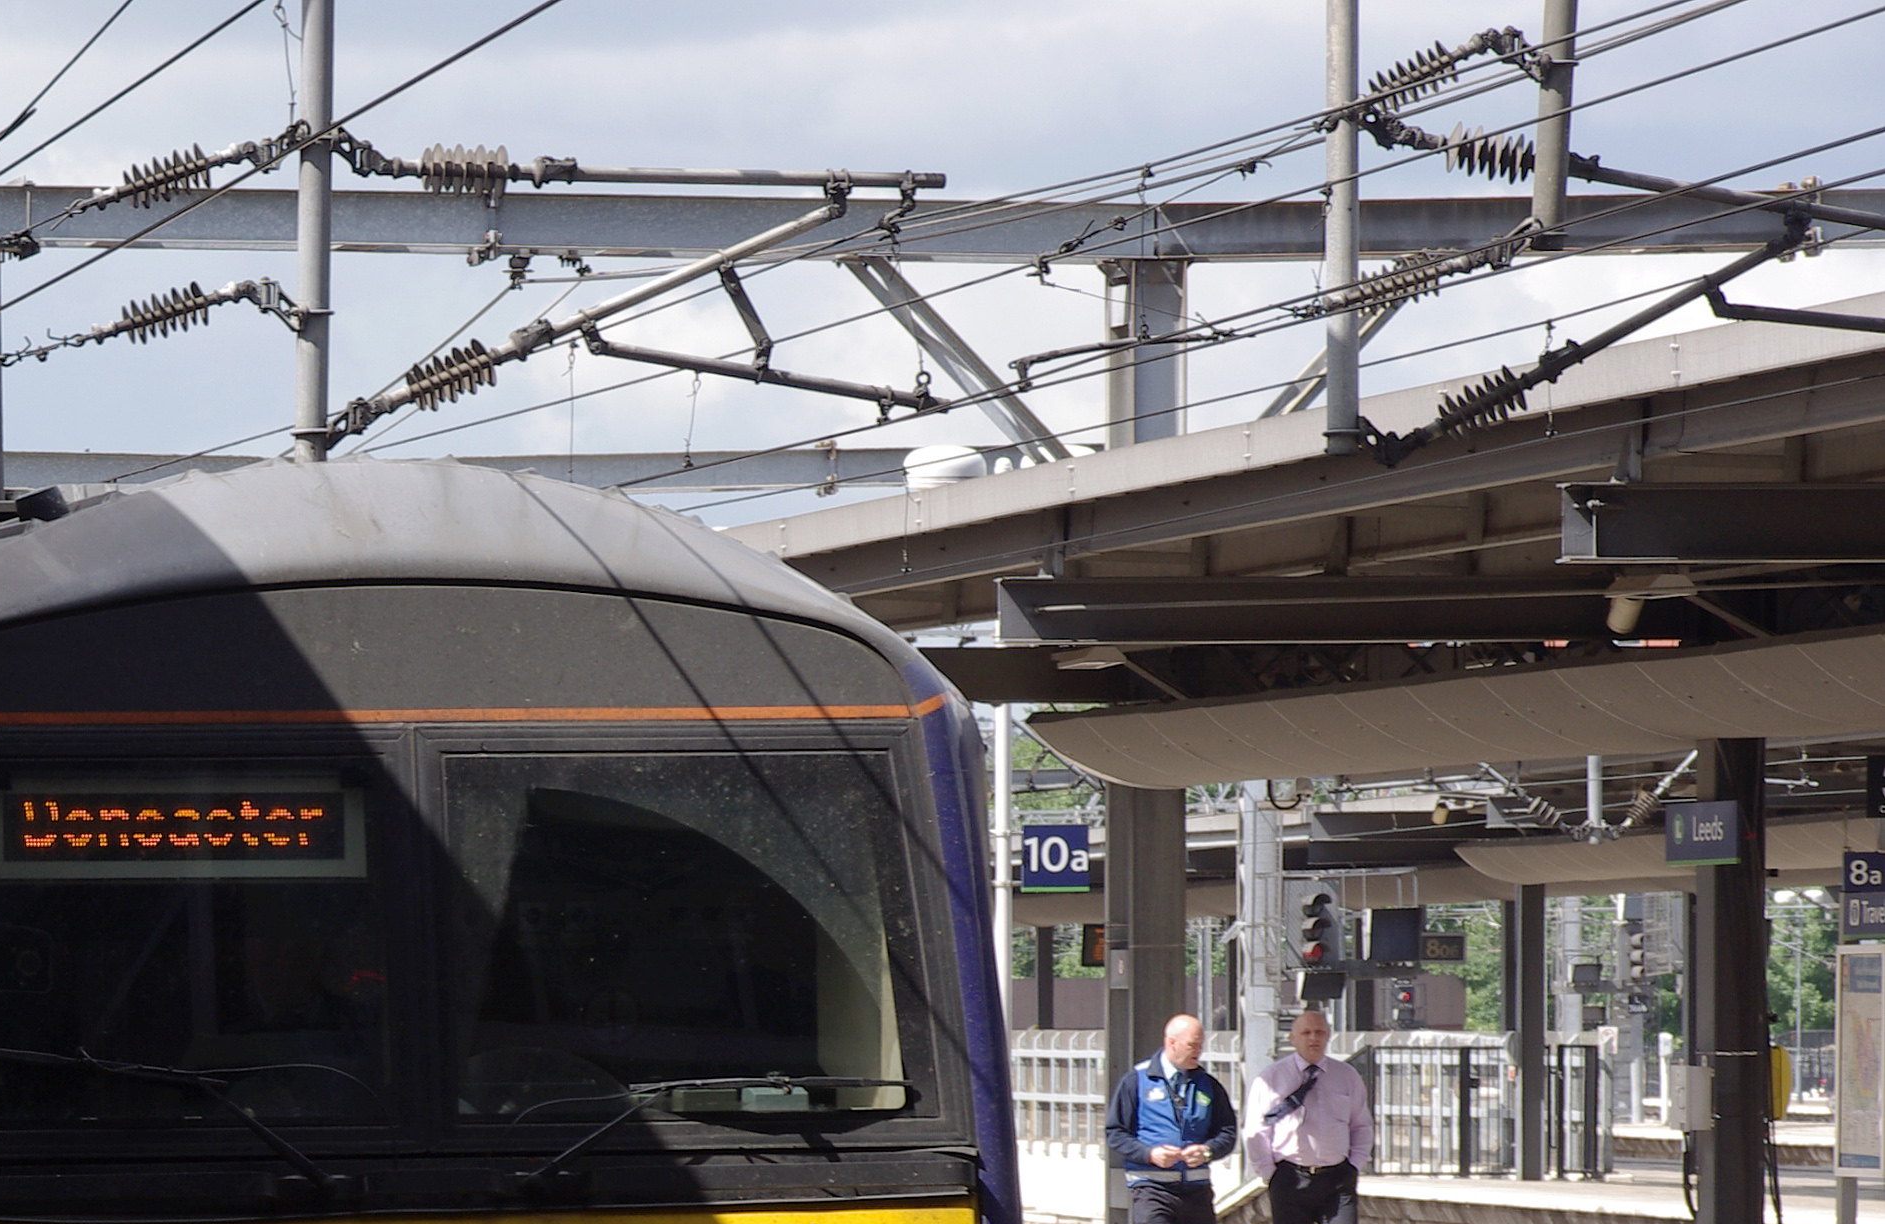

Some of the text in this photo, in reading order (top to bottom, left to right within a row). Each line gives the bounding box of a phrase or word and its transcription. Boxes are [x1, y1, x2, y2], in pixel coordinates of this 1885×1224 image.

[23, 799, 325, 849] Doncaster
[1692, 814, 1724, 842] Leeds
[1024, 835, 1090, 874] 10a
[1849, 859, 1883, 886] 8a
